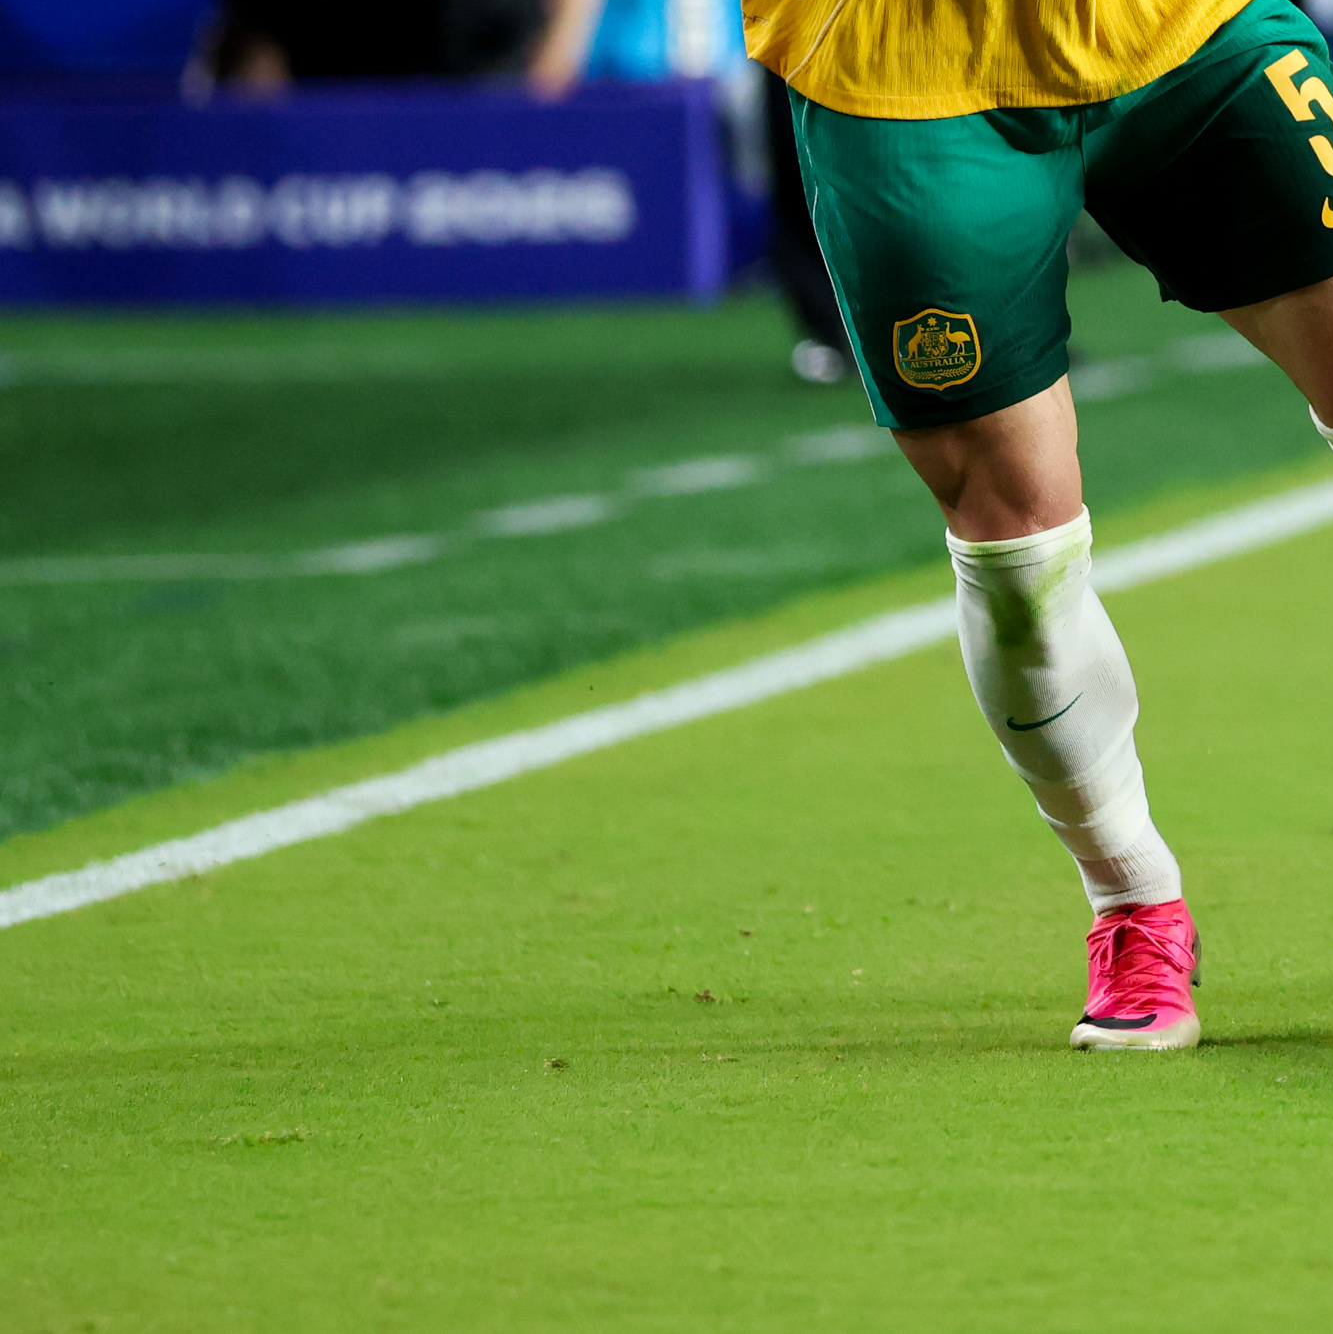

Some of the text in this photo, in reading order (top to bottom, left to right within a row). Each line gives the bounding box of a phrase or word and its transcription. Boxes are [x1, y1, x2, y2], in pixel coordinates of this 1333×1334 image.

[36, 174, 264, 250] WORLD
[268, 172, 402, 249] CUP
[404, 168, 638, 245] 2026
[910, 356, 966, 369] AUSTRALIA
